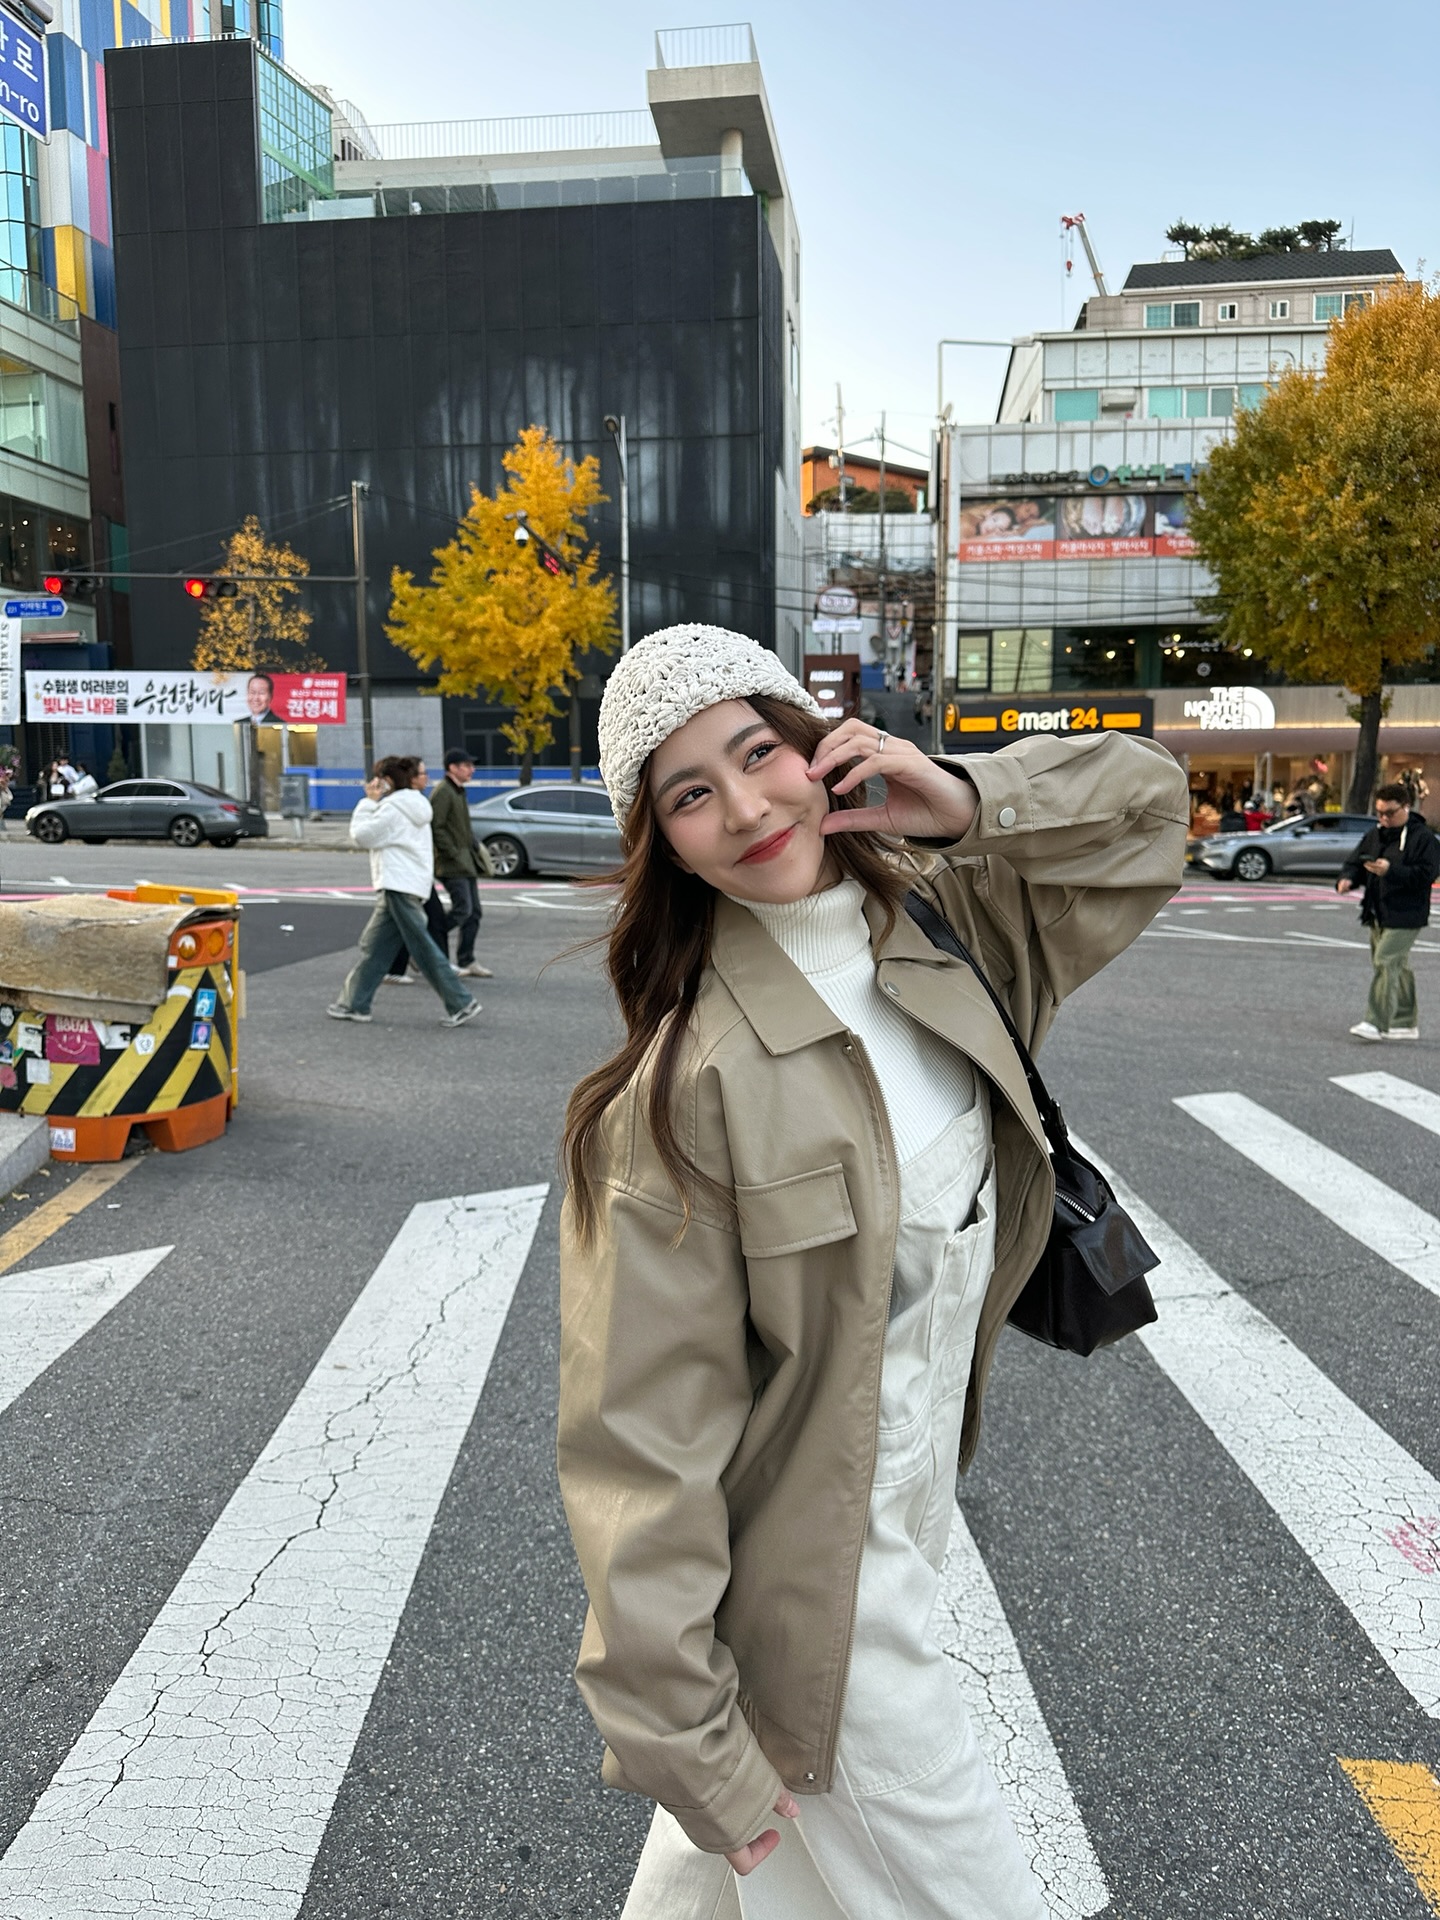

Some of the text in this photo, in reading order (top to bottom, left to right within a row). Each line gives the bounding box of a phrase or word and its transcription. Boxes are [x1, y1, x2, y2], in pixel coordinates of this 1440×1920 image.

[43, 679, 129, 694] 수험생 여러분의
[1210, 686, 1244, 702] THE
[133, 678, 238, 716] 응원합니다
[43, 697, 129, 715] 빛나는 내일을
[287, 699, 338, 719] 권영세
[1184, 700, 1244, 717] NORTH
[1001, 708, 1100, 732] emart24
[1200, 714, 1244, 730] FACE
